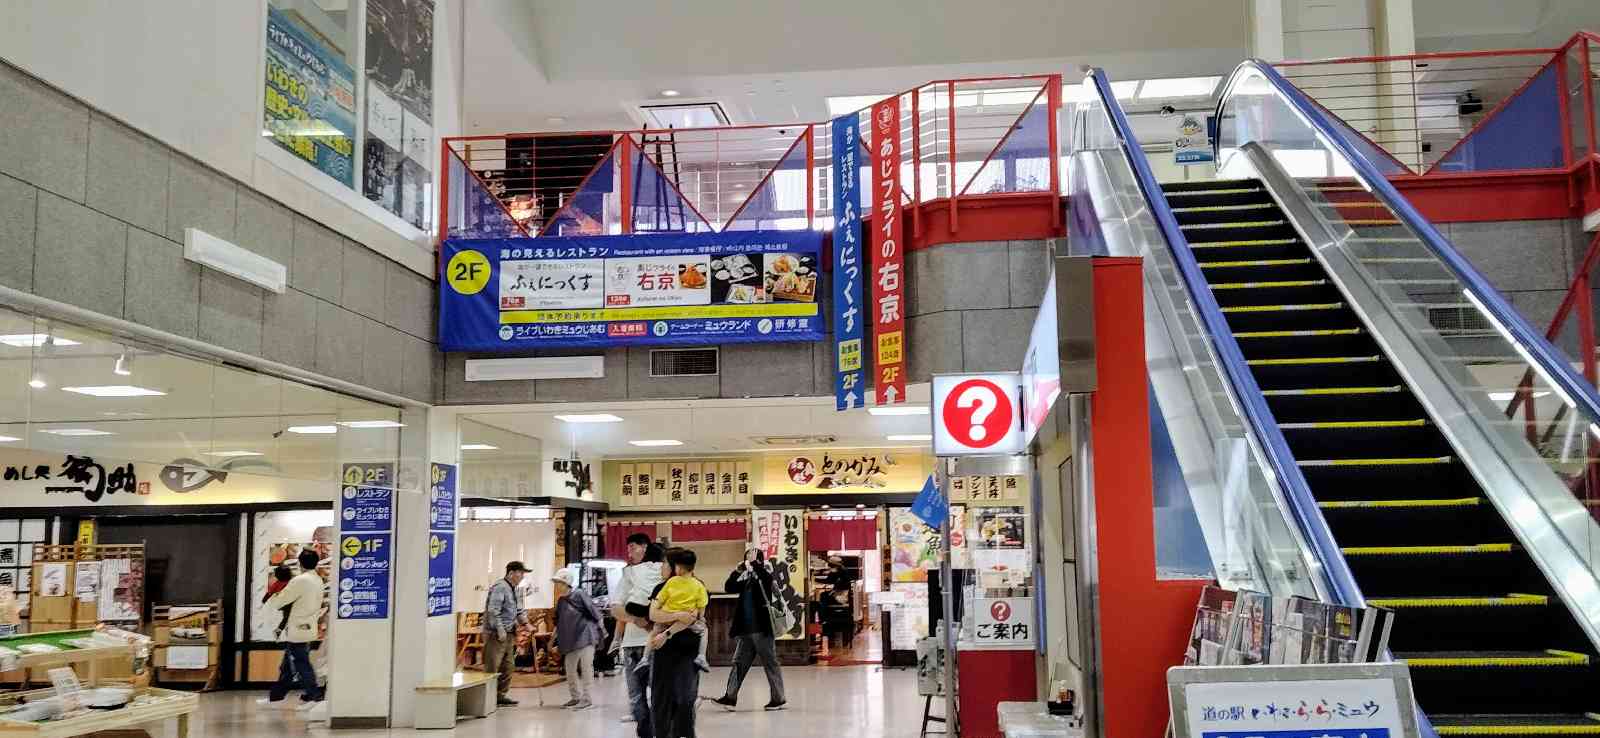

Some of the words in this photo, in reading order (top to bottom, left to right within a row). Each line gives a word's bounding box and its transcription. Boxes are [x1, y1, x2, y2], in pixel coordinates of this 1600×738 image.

[878, 137, 900, 324] あじフライの右京
[500, 247, 609, 259] 海の見えるレストラン
[455, 262, 484, 281] 2F
[510, 273, 593, 291] ふぇにっくす
[637, 272, 675, 290] 右京
[704, 319, 751, 331] ミュウランド
[842, 373, 859, 390] 2F
[882, 366, 900, 384] 2F
[366, 468, 385, 481] 2F
[738, 472, 750, 494] 平目
[671, 468, 683, 502] 秋刀魚
[705, 473, 716, 495] 目光
[357, 489, 390, 497] レストラン
[363, 538, 384, 553] 1F
[784, 514, 799, 573] いわきの
[353, 578, 375, 587] トイレ
[976, 623, 1029, 640] ご案内
[1201, 705, 1246, 721] 道の駅
